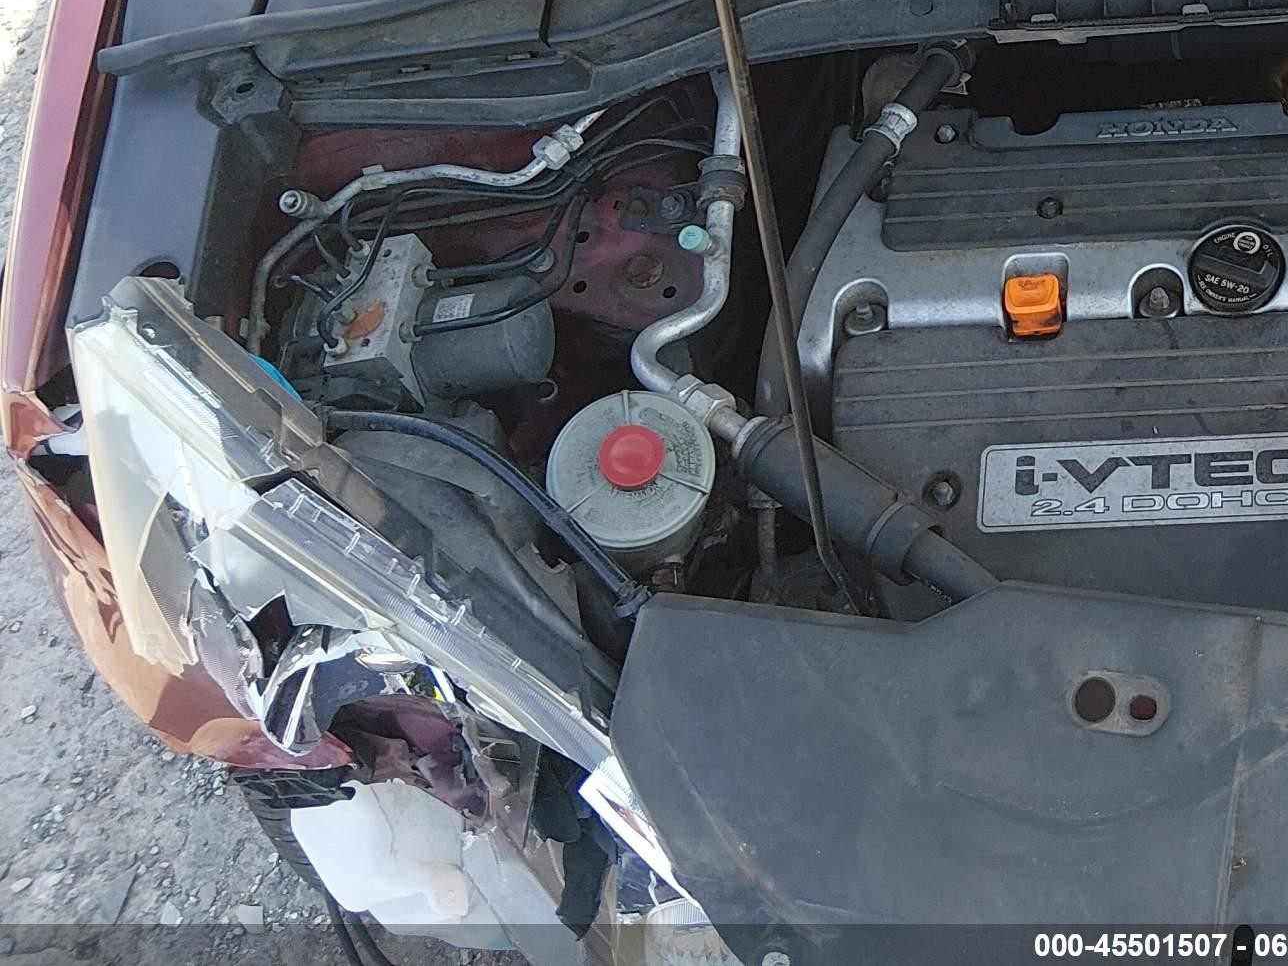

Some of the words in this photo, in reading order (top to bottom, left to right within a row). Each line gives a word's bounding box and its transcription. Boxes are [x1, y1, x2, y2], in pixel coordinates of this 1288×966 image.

[1097, 115, 1238, 139] HONDA
[1262, 244, 1274, 258] OIL
[1204, 274, 1220, 285] SAE
[1220, 279, 1250, 294] 5W-20
[1030, 494, 1111, 518] 2.4
